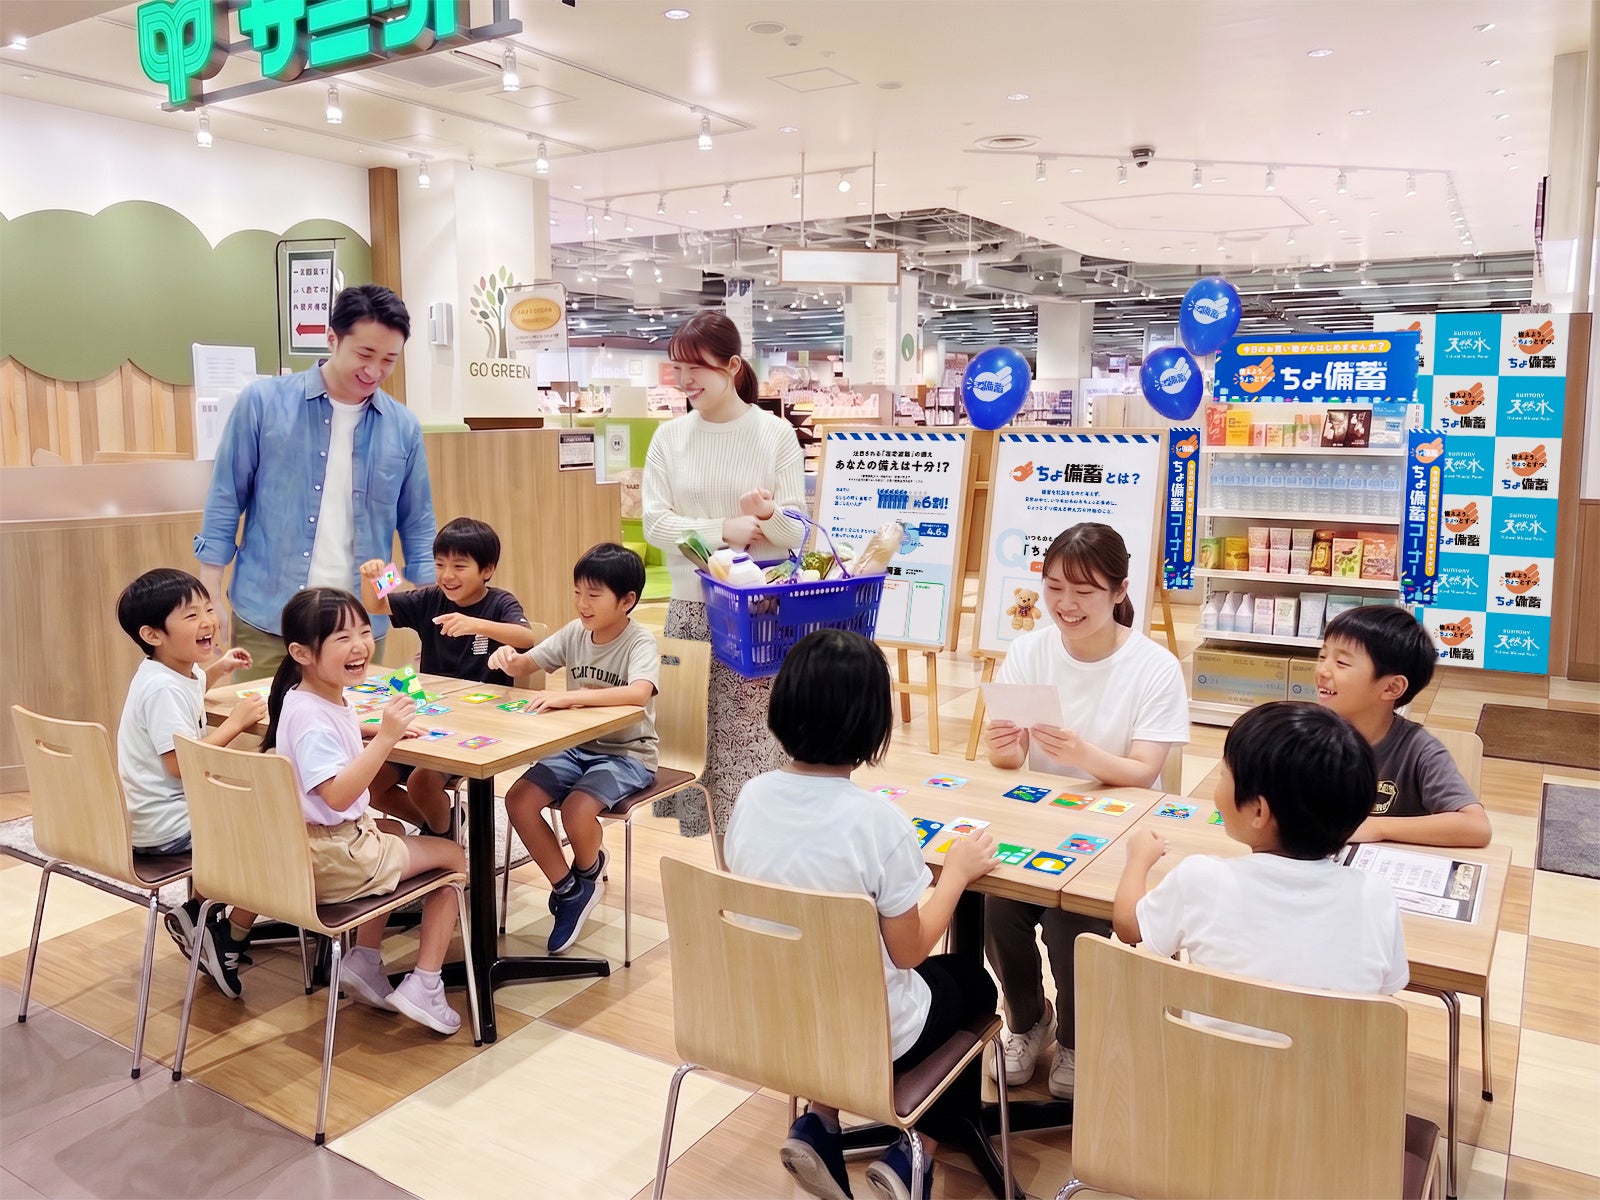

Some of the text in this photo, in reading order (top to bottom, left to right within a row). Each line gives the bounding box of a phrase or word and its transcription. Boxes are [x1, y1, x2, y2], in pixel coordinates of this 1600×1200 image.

[470, 362, 530, 379] GO GREEN
[1280, 360, 1388, 391] ちょ備蓄
[835, 459, 950, 473] あなたの備えは十分!?
[1170, 460, 1185, 562] ちょ備蓄コーナー
[1407, 465, 1427, 576] ちょ備蓄コーナー
